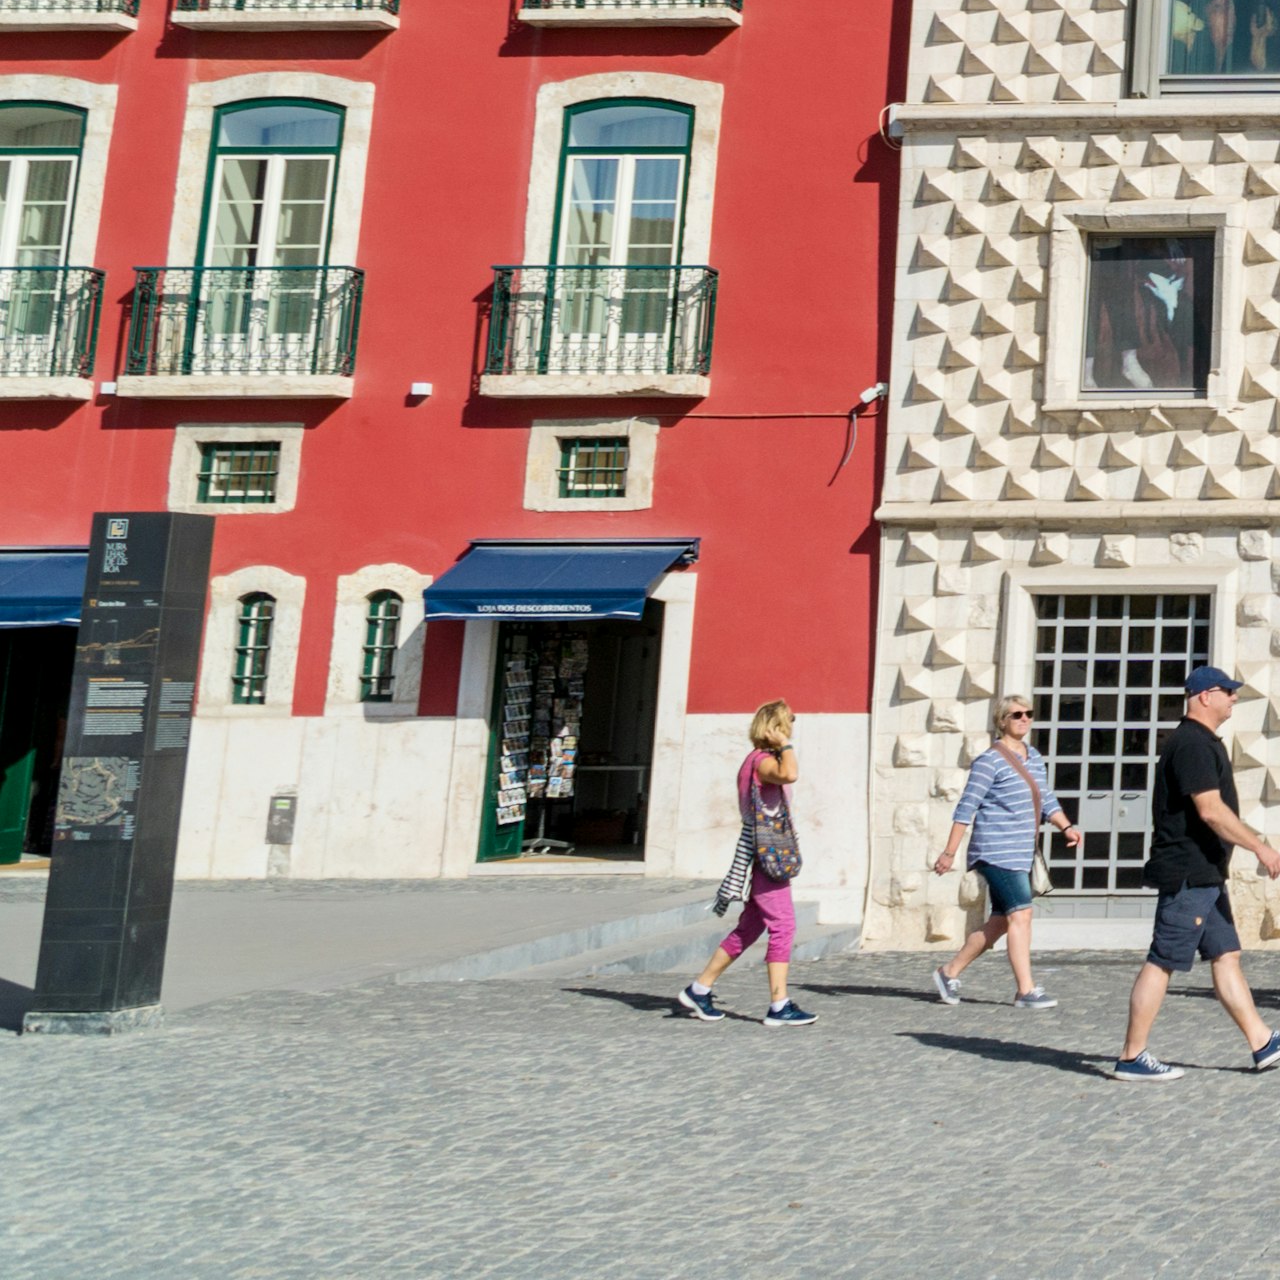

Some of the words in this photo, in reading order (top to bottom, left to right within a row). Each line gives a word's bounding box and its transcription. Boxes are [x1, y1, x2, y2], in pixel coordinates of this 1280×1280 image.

[477, 604, 496, 613] LOJA
[497, 604, 514, 612] DOS
[515, 604, 592, 612] DESCOBRIMENTOS
